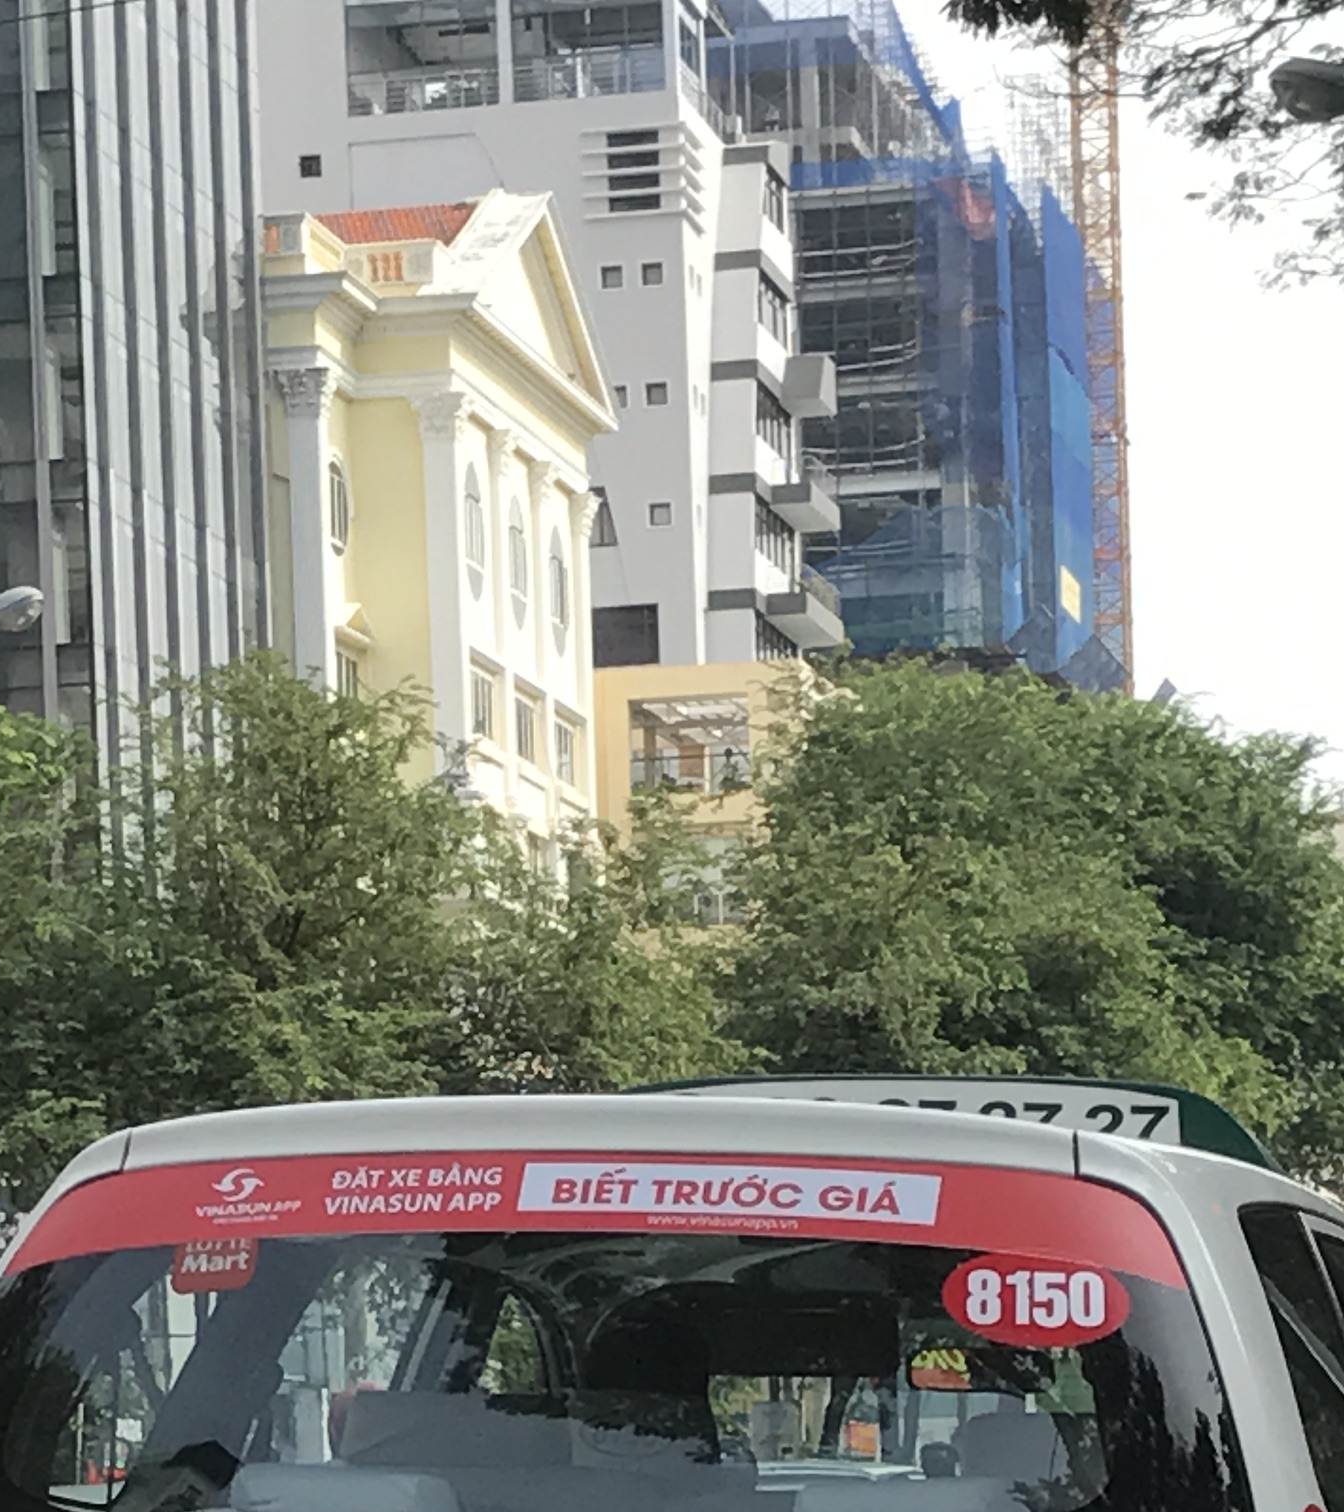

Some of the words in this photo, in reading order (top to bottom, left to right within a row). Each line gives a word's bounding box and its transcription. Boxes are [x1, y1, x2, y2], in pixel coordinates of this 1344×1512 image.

[388, 1168, 422, 1188] XE
[552, 1168, 638, 1204] BIẾT
[651, 1174, 804, 1208] TRƯỚC
[818, 1181, 901, 1215] GIÁ
[195, 1201, 272, 1217] VINASUN
[324, 1193, 444, 1215] VINASUN
[447, 1192, 502, 1212] APP
[181, 1252, 250, 1273] Mart
[966, 1269, 1106, 1329] 8150
